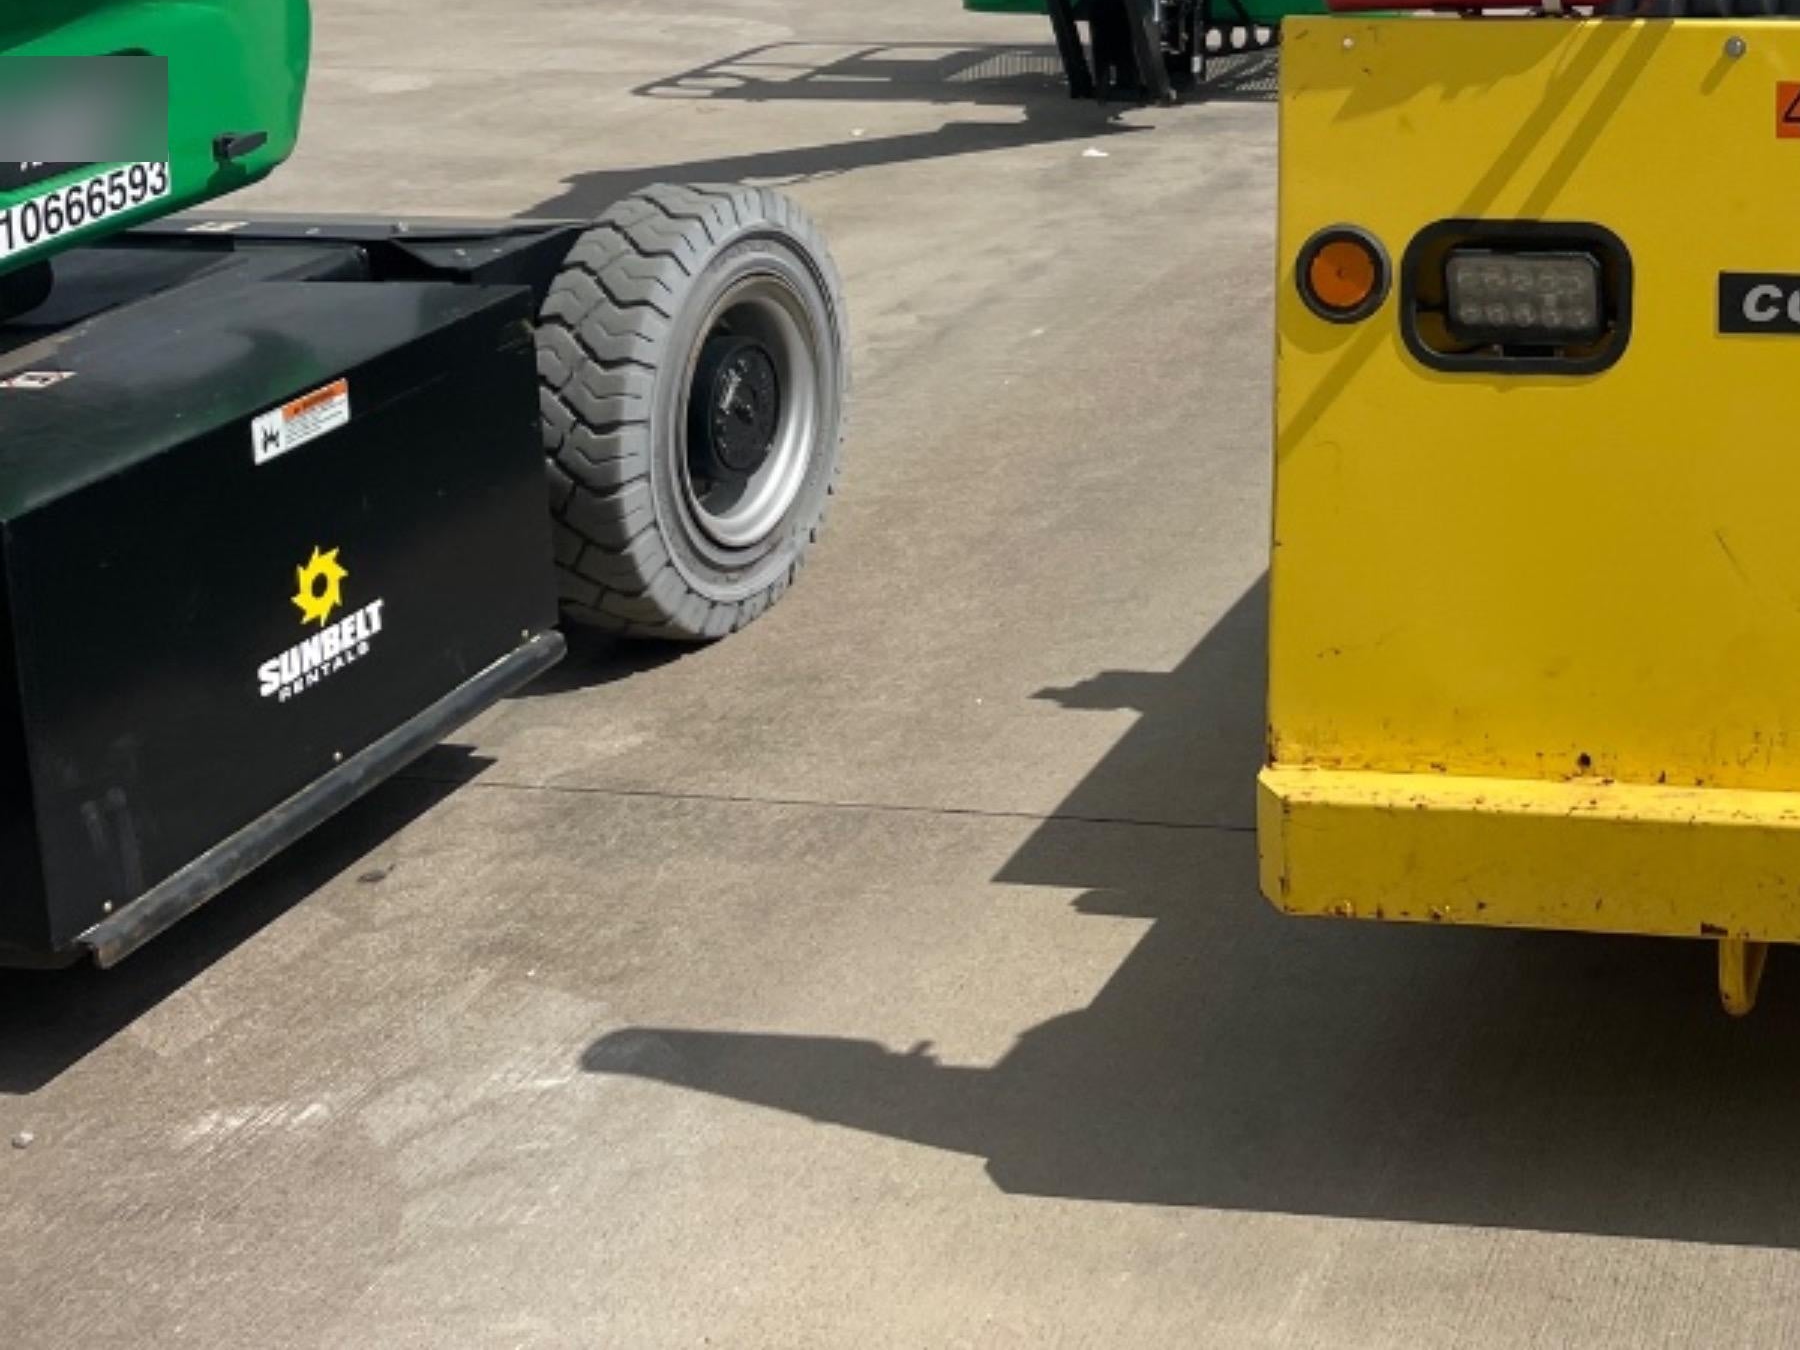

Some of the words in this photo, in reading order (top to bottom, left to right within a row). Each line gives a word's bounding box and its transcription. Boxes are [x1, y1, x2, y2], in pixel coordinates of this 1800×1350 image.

[0, 160, 167, 250] 10666593
[258, 598, 384, 697] SUNBELT
[278, 641, 369, 702] RENTALS
